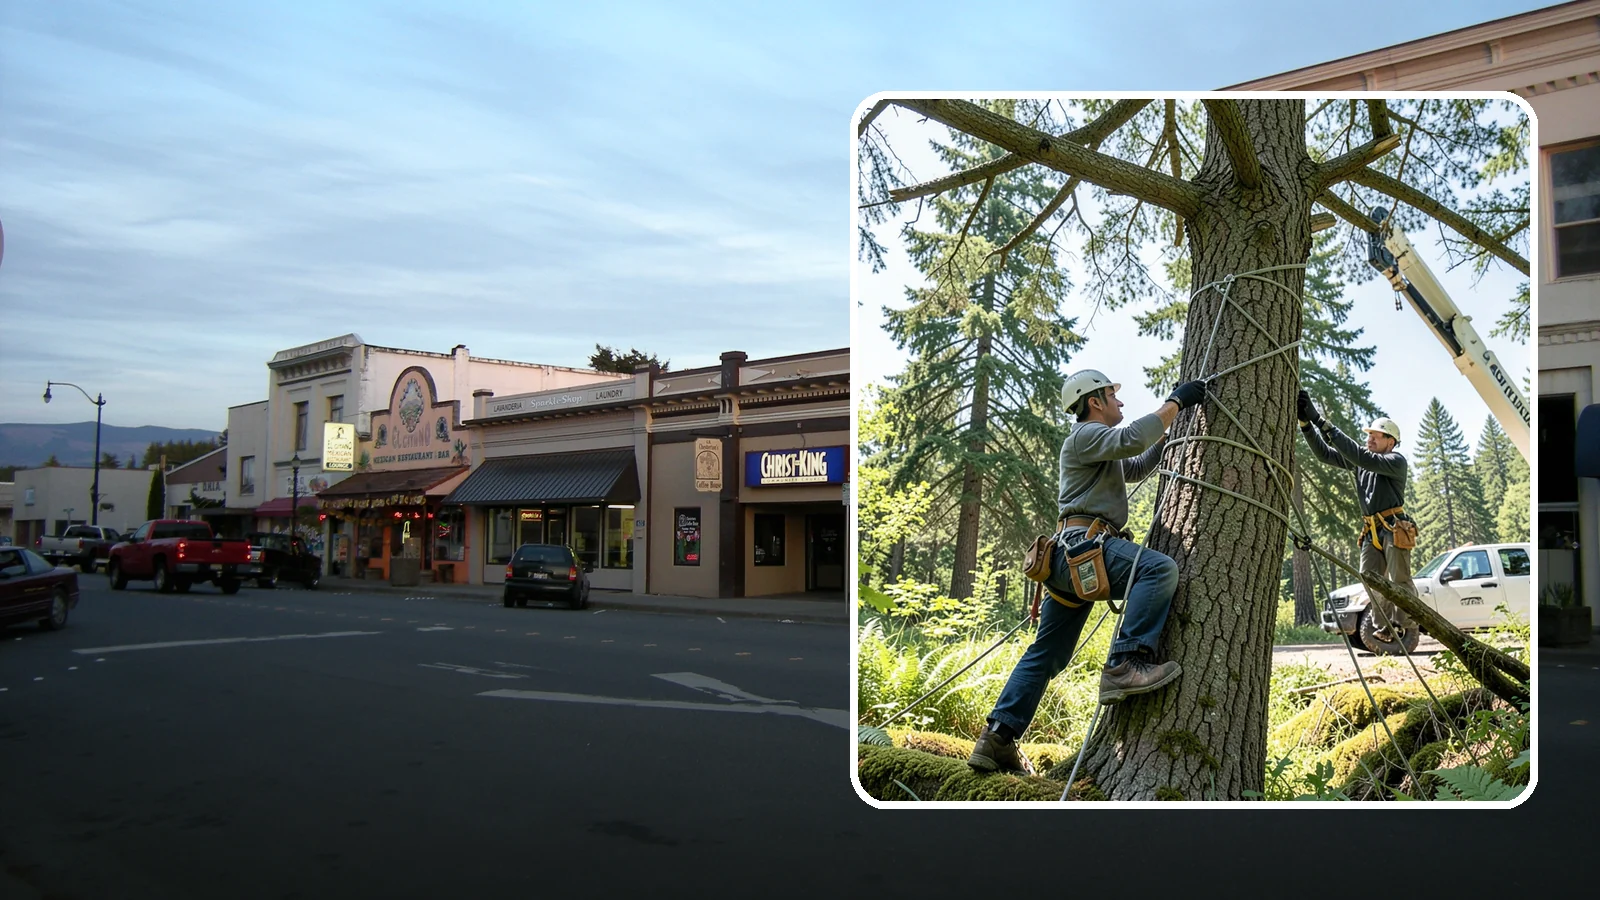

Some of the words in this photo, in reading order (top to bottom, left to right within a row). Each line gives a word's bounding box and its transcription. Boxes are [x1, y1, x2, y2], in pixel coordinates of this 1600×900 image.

[493, 402, 522, 413] LAVANDERIA
[595, 388, 623, 400] LAUNDRY
[373, 454, 396, 464] MEXICAN
[397, 451, 434, 462] RESTAURANT
[437, 450, 450, 459] BAR
[761, 452, 797, 478] CHRIST
[799, 450, 827, 476] KING
